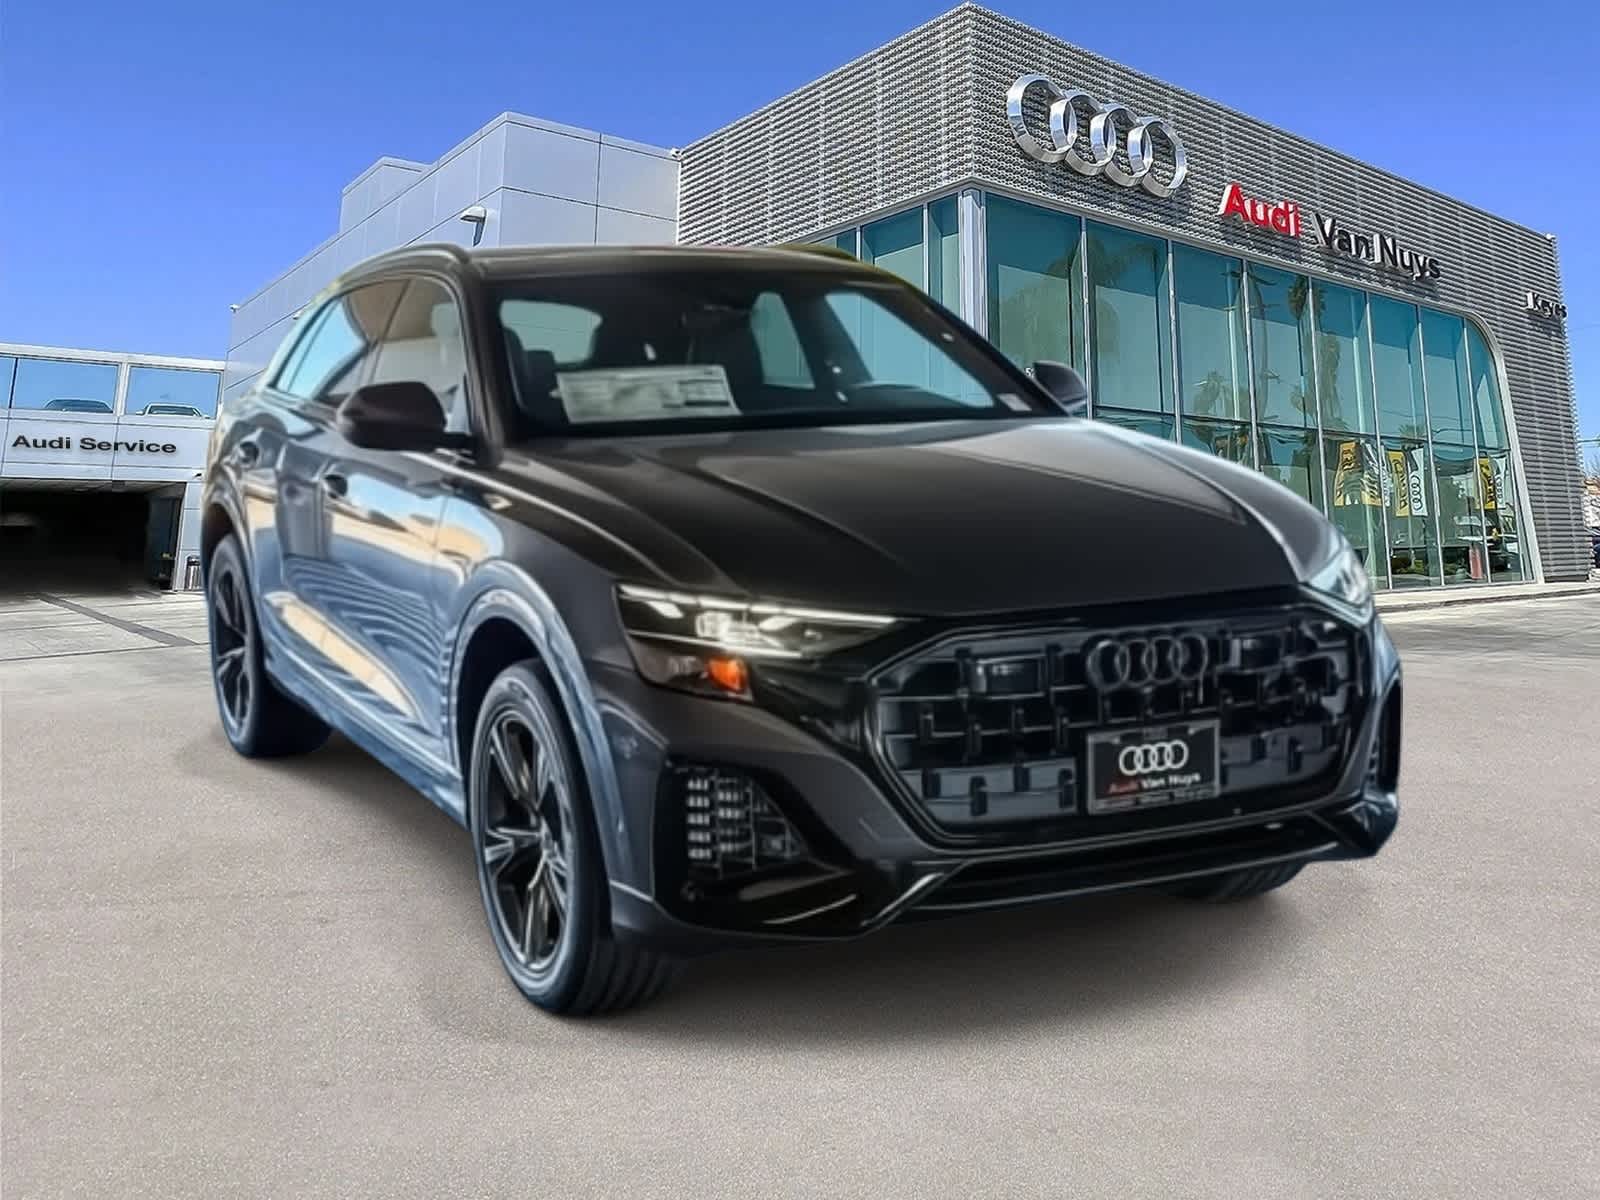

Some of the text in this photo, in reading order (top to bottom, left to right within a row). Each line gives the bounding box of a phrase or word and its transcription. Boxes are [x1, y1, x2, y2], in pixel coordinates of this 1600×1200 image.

[1219, 182, 1441, 280] Audi Van Nuys
[1528, 291, 1568, 319] Keyes
[12, 434, 177, 454] Audi Service
